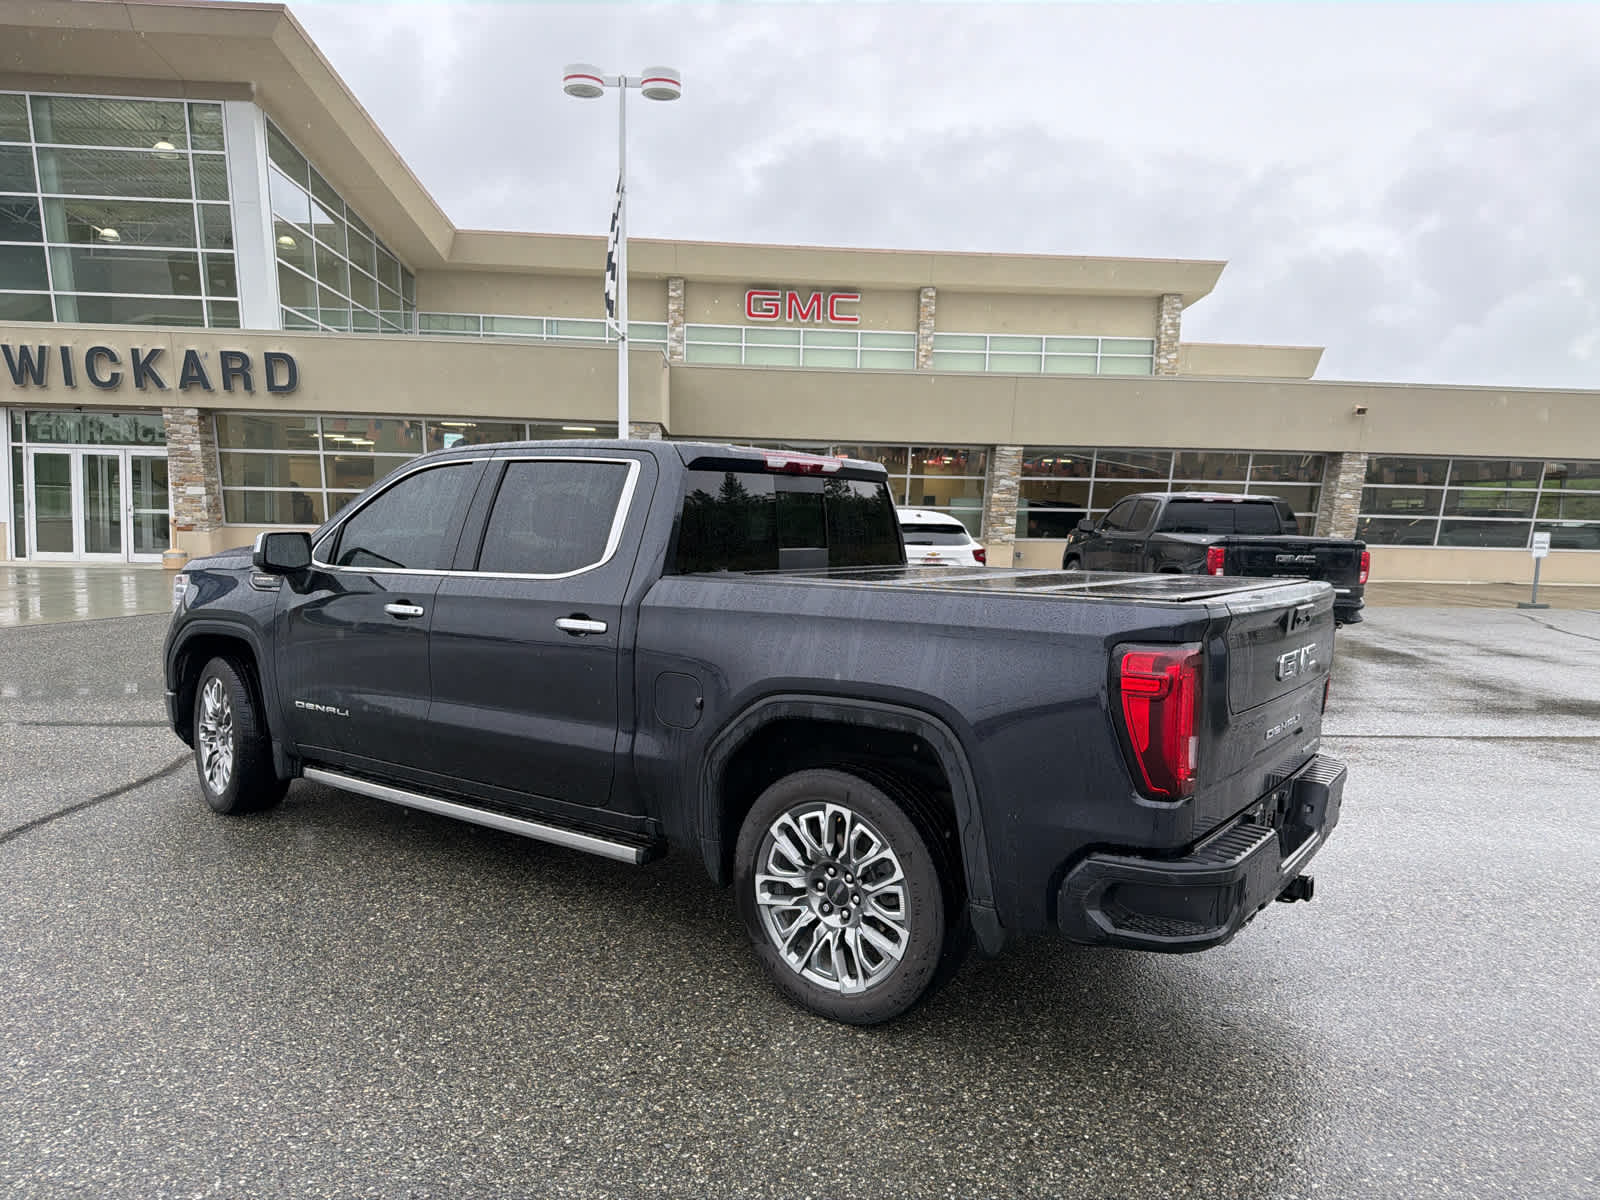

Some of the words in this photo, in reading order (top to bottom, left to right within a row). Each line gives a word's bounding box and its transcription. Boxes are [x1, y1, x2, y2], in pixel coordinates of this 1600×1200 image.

[745, 290, 860, 324] GMC
[0, 343, 299, 393] WICKARD
[295, 700, 350, 717] DENALI
